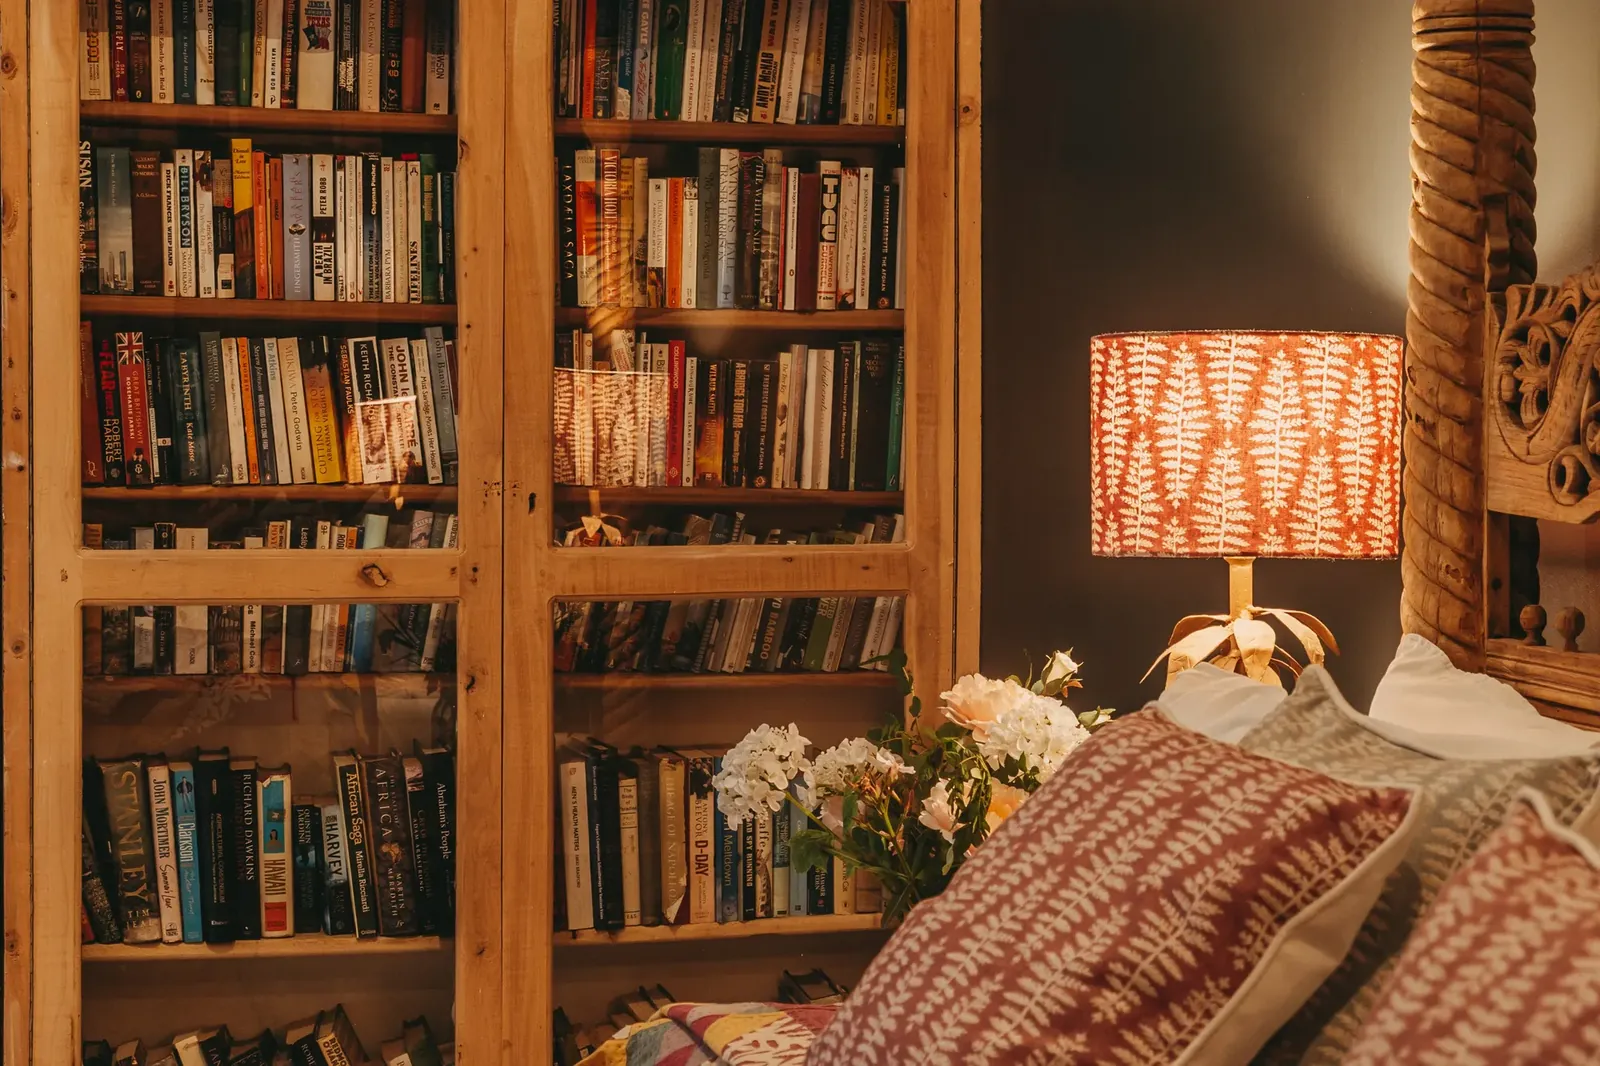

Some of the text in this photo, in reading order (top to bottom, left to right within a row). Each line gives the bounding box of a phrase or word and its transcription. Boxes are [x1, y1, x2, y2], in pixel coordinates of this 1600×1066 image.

[115, 0, 123, 21] YOUR
[640, 12, 649, 44] GAYLE
[856, 37, 865, 60] Rising
[756, 85, 770, 108] ANDY
[80, 141, 91, 187] SUSAN
[604, 156, 617, 220] VICTORIA HOLT
[181, 196, 190, 246] BRYSON
[727, 152, 737, 273] A TALE
[753, 164, 763, 255] THE WHITE NILE
[703, 201, 713, 279] Dearest Augusta
[718, 208, 727, 261] HARRISON
[324, 245, 332, 274] BRAZIL
[410, 241, 418, 301] LIFELINES
[564, 241, 574, 279] SAGA
[99, 352, 115, 391] FEAR
[211, 340, 219, 368] UMBERTO
[267, 343, 276, 380] Dr Atkins
[396, 346, 408, 382] JOHN
[433, 337, 447, 400] John Banville
[132, 371, 140, 394] GREAT
[180, 352, 191, 410] LABYRINTH
[186, 422, 194, 439] Kate
[340, 345, 354, 414] SEBASTIAN FAULKS
[360, 343, 375, 420] KEITH RICHARDS
[401, 388, 410, 396] le
[420, 377, 428, 390] Miss
[708, 364, 716, 391] WILBUR
[734, 370, 745, 397] BRIDGE
[762, 374, 770, 403] FREDERICK
[820, 360, 831, 411] Aristocrats
[134, 398, 142, 427] BRITISH
[284, 345, 295, 388] MUKIWA
[293, 417, 302, 451] Godwin
[734, 399, 744, 413] TOO
[732, 414, 743, 429] FAR
[760, 405, 768, 432] FORSYTH
[104, 419, 114, 462] HARRIS
[112, 419, 122, 461] ROBERT
[315, 426, 327, 474] CUTTING
[324, 425, 333, 461] ABRAHAM
[760, 612, 780, 660] BAMBOO
[153, 779, 170, 858] JOHN MORTIMER
[375, 768, 392, 837] AFRICA
[436, 783, 451, 859] Abraham's People
[665, 797, 675, 820] AGE
[112, 771, 148, 902] STANLEY
[178, 823, 194, 862] Clarkson
[215, 813, 223, 858] AGRICULTURAL
[243, 774, 255, 881] RICHARD DAWKINS
[297, 809, 305, 844] JARDINE
[346, 772, 371, 913] African Saga Mirella Ricciardi
[667, 824, 676, 836] OF
[745, 836, 753, 850] SPY
[326, 824, 342, 876] HARVEY
[695, 840, 709, 876] D-DAY
[723, 835, 734, 886] Meltdown
[264, 859, 286, 895] HAWAII
[387, 867, 398, 916] MEREDITH
[396, 872, 405, 909] MARTIN
